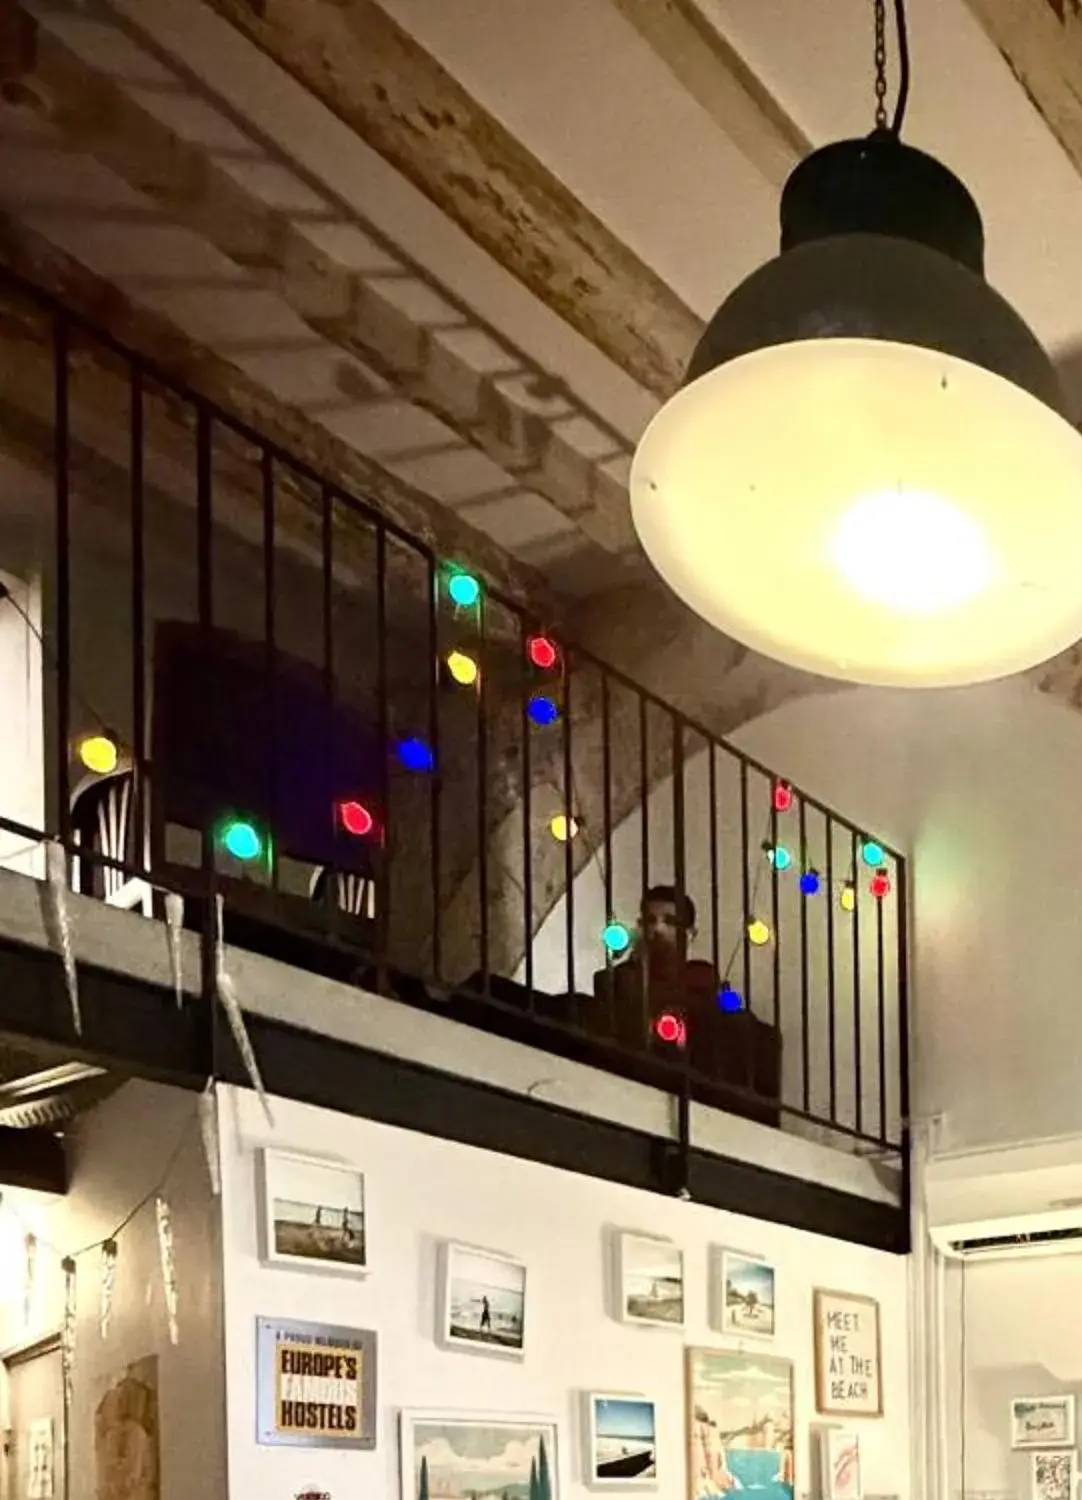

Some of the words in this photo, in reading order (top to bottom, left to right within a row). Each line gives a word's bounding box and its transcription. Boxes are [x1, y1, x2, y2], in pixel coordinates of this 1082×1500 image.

[827, 1311, 860, 1331] MEET
[831, 1335, 848, 1354] ME
[281, 1350, 358, 1380] EUROPE'S
[829, 1356, 844, 1375] AT
[849, 1355, 873, 1378] THE
[831, 1381, 868, 1400] BEACH
[281, 1400, 358, 1431] HOSTELS
